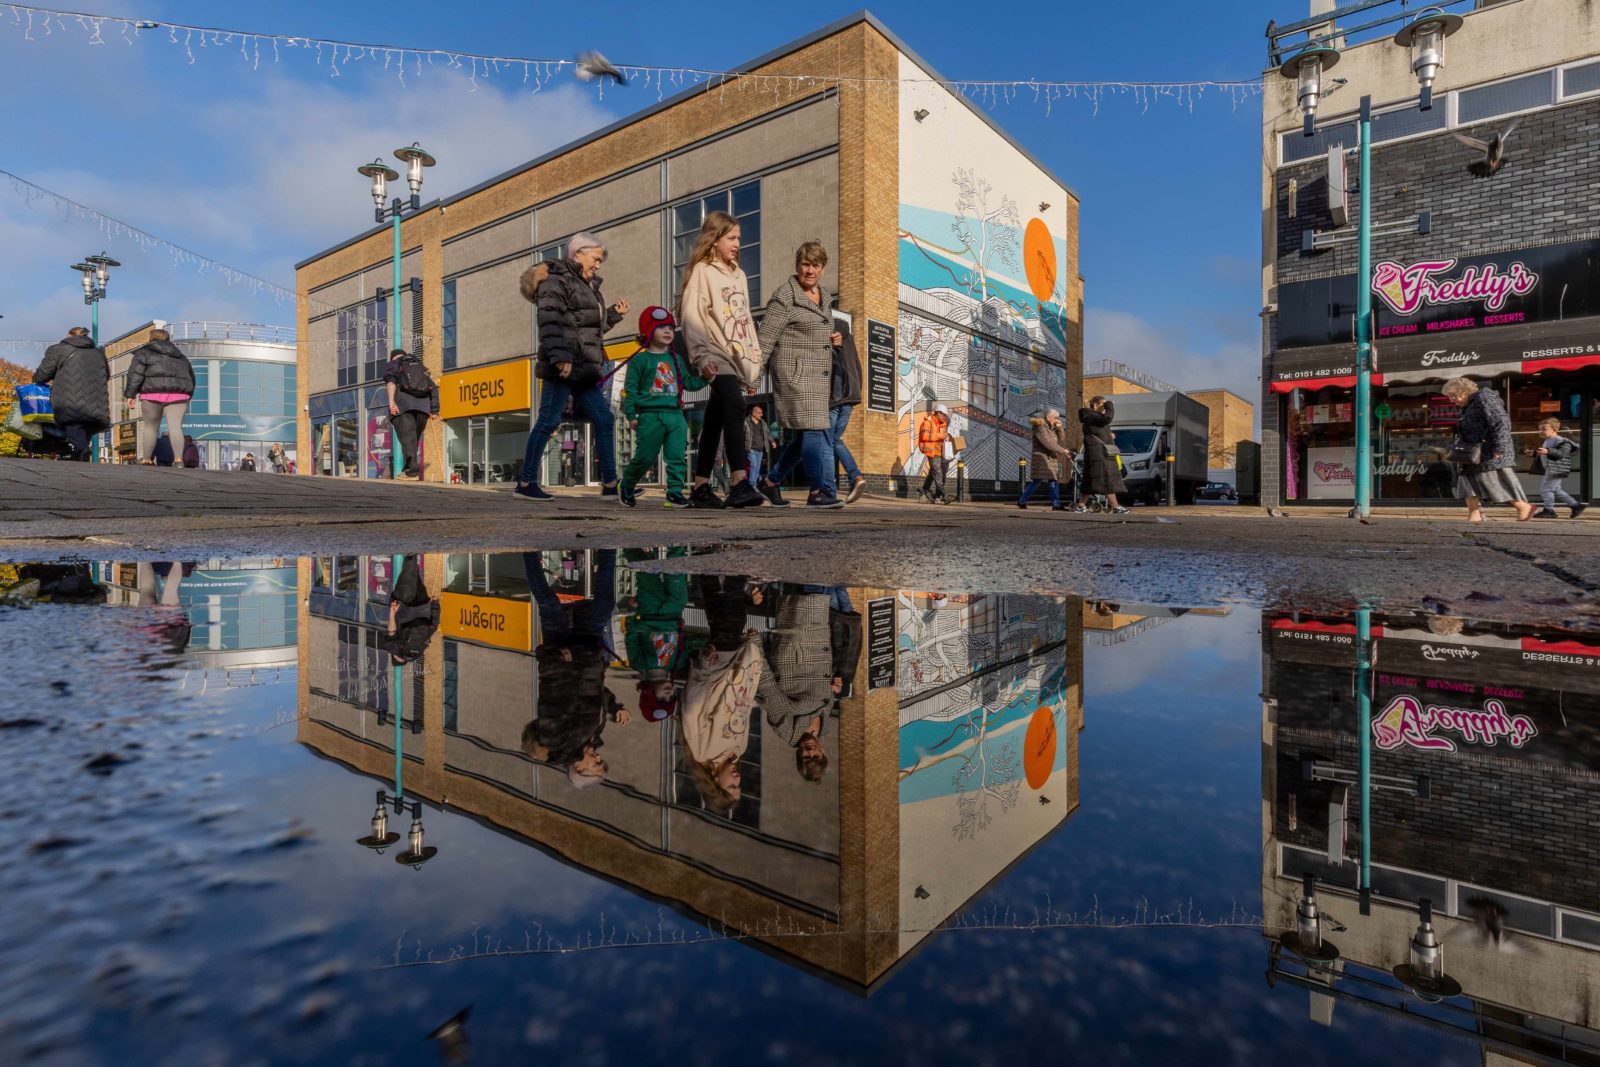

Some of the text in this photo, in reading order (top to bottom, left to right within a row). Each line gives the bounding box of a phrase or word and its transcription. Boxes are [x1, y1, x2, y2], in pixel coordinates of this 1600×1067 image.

[1398, 260, 1536, 312] Freddy's
[1380, 312, 1525, 337] ICE CREAM MILKSHAKES DESSERTS
[1421, 350, 1480, 367] Freddy's
[1523, 346, 1584, 359] DESSERTS
[1294, 370, 1313, 379] 0151
[1315, 368, 1331, 377] 482
[1332, 367, 1353, 375] 1009
[459, 379, 505, 406] ingeus
